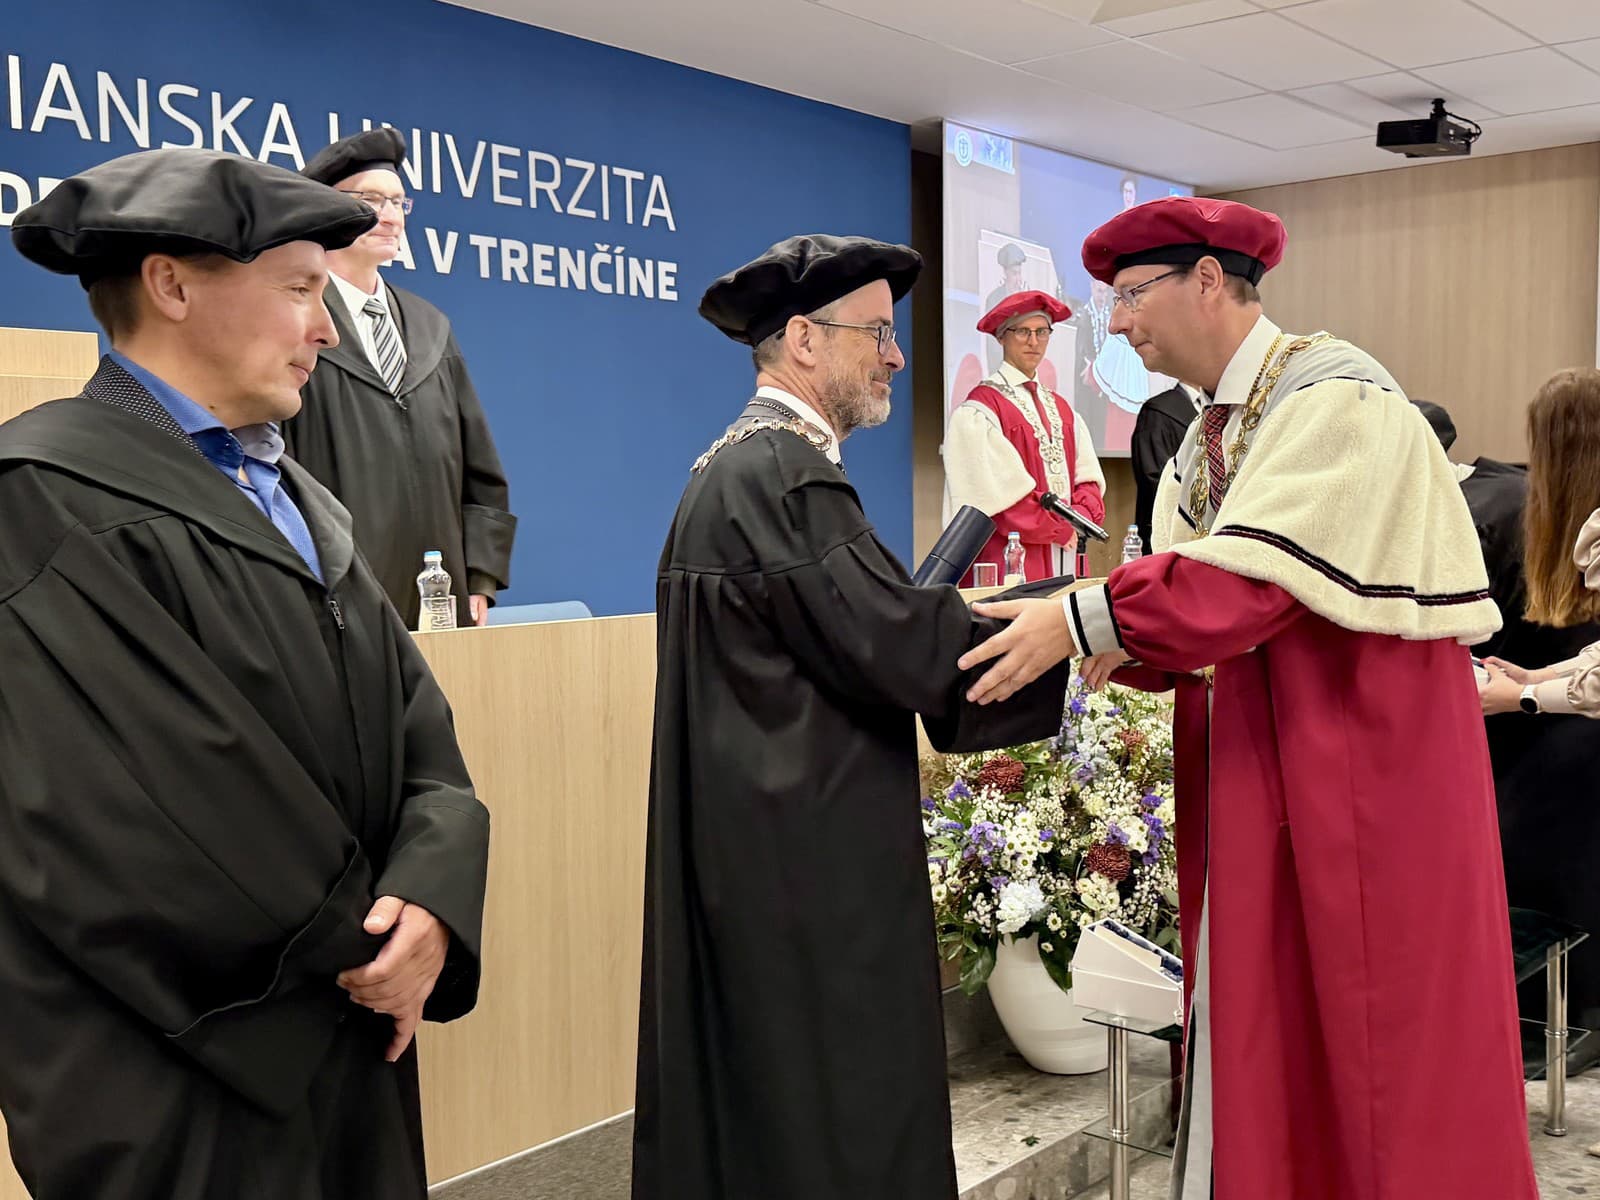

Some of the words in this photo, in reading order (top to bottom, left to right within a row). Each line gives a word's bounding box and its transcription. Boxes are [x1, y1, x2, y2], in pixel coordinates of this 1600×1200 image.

[8, 54, 306, 171] IANSKA
[424, 227, 459, 275] V
[469, 234, 679, 302] TRENČÍNE
